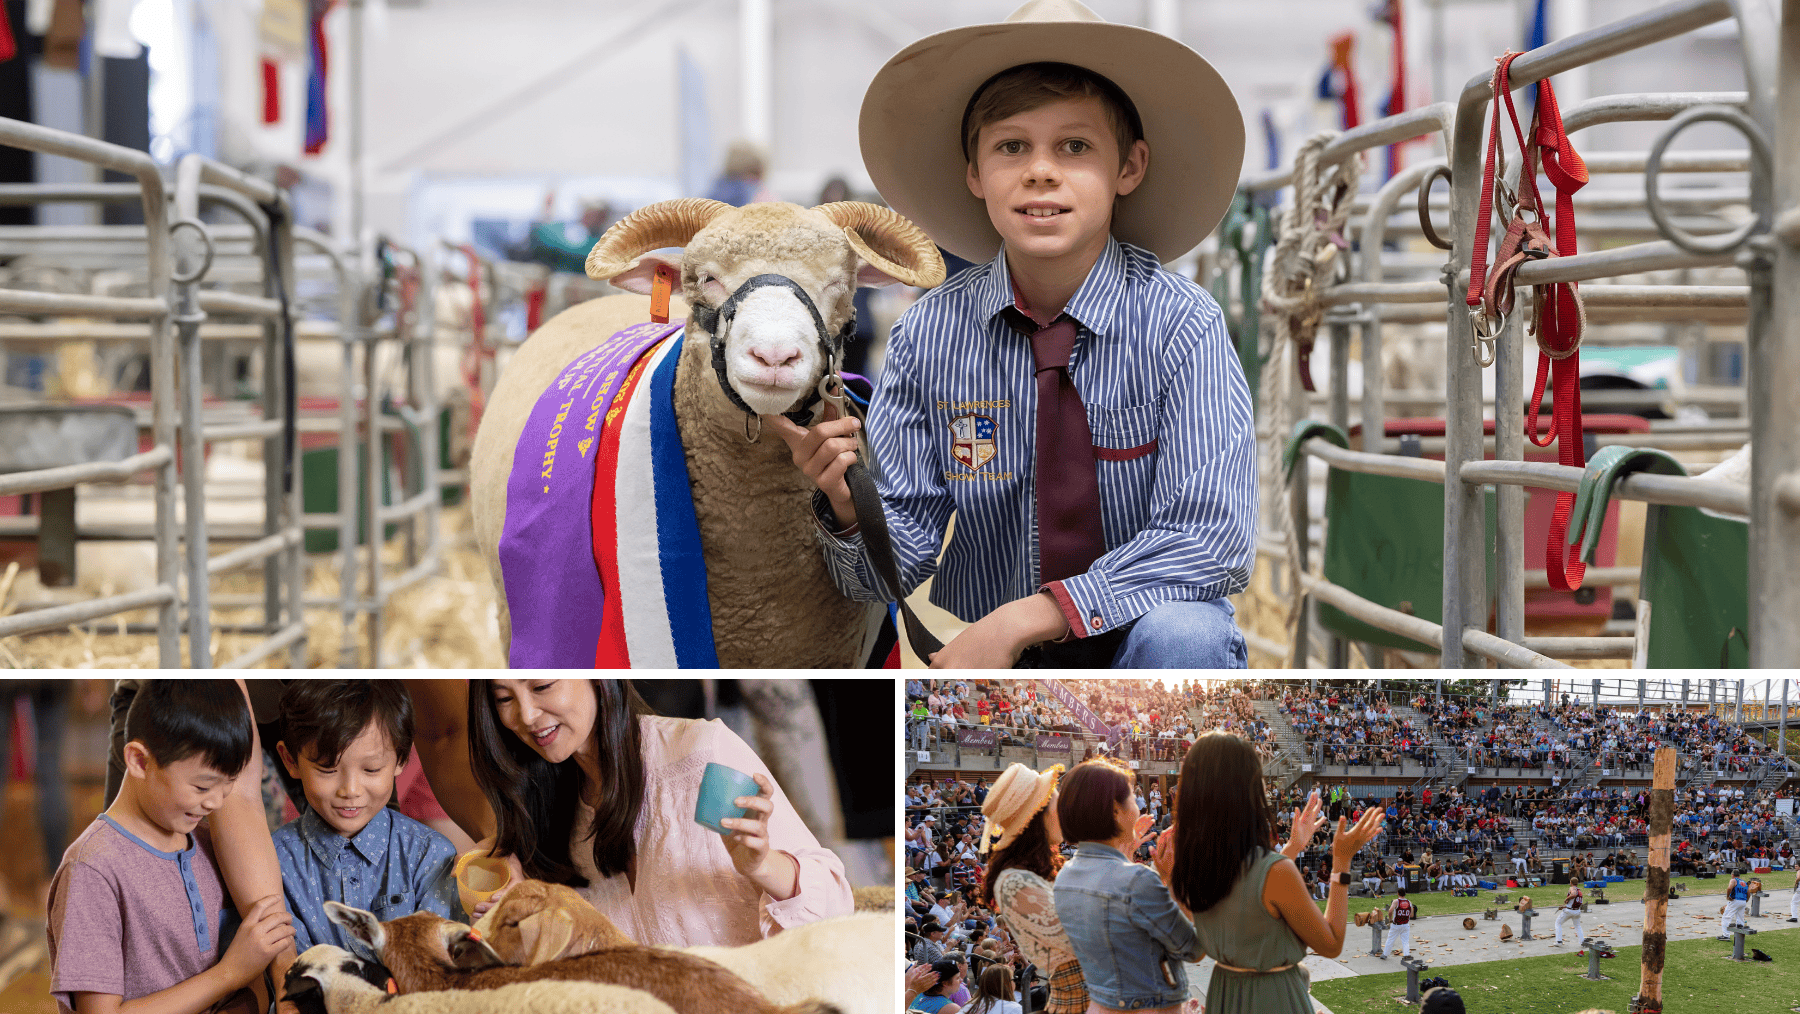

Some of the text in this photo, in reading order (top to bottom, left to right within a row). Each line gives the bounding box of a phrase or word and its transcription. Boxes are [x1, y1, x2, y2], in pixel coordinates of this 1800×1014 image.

[585, 371, 619, 432] SHOW
[953, 400, 1011, 410] LAWRENCES
[541, 398, 574, 479] TROPHY
[945, 471, 1013, 482] SHOW TEAM
[1043, 679, 1096, 730] MEMBERS
[961, 731, 994, 745] Members
[1038, 739, 1069, 750] Members
